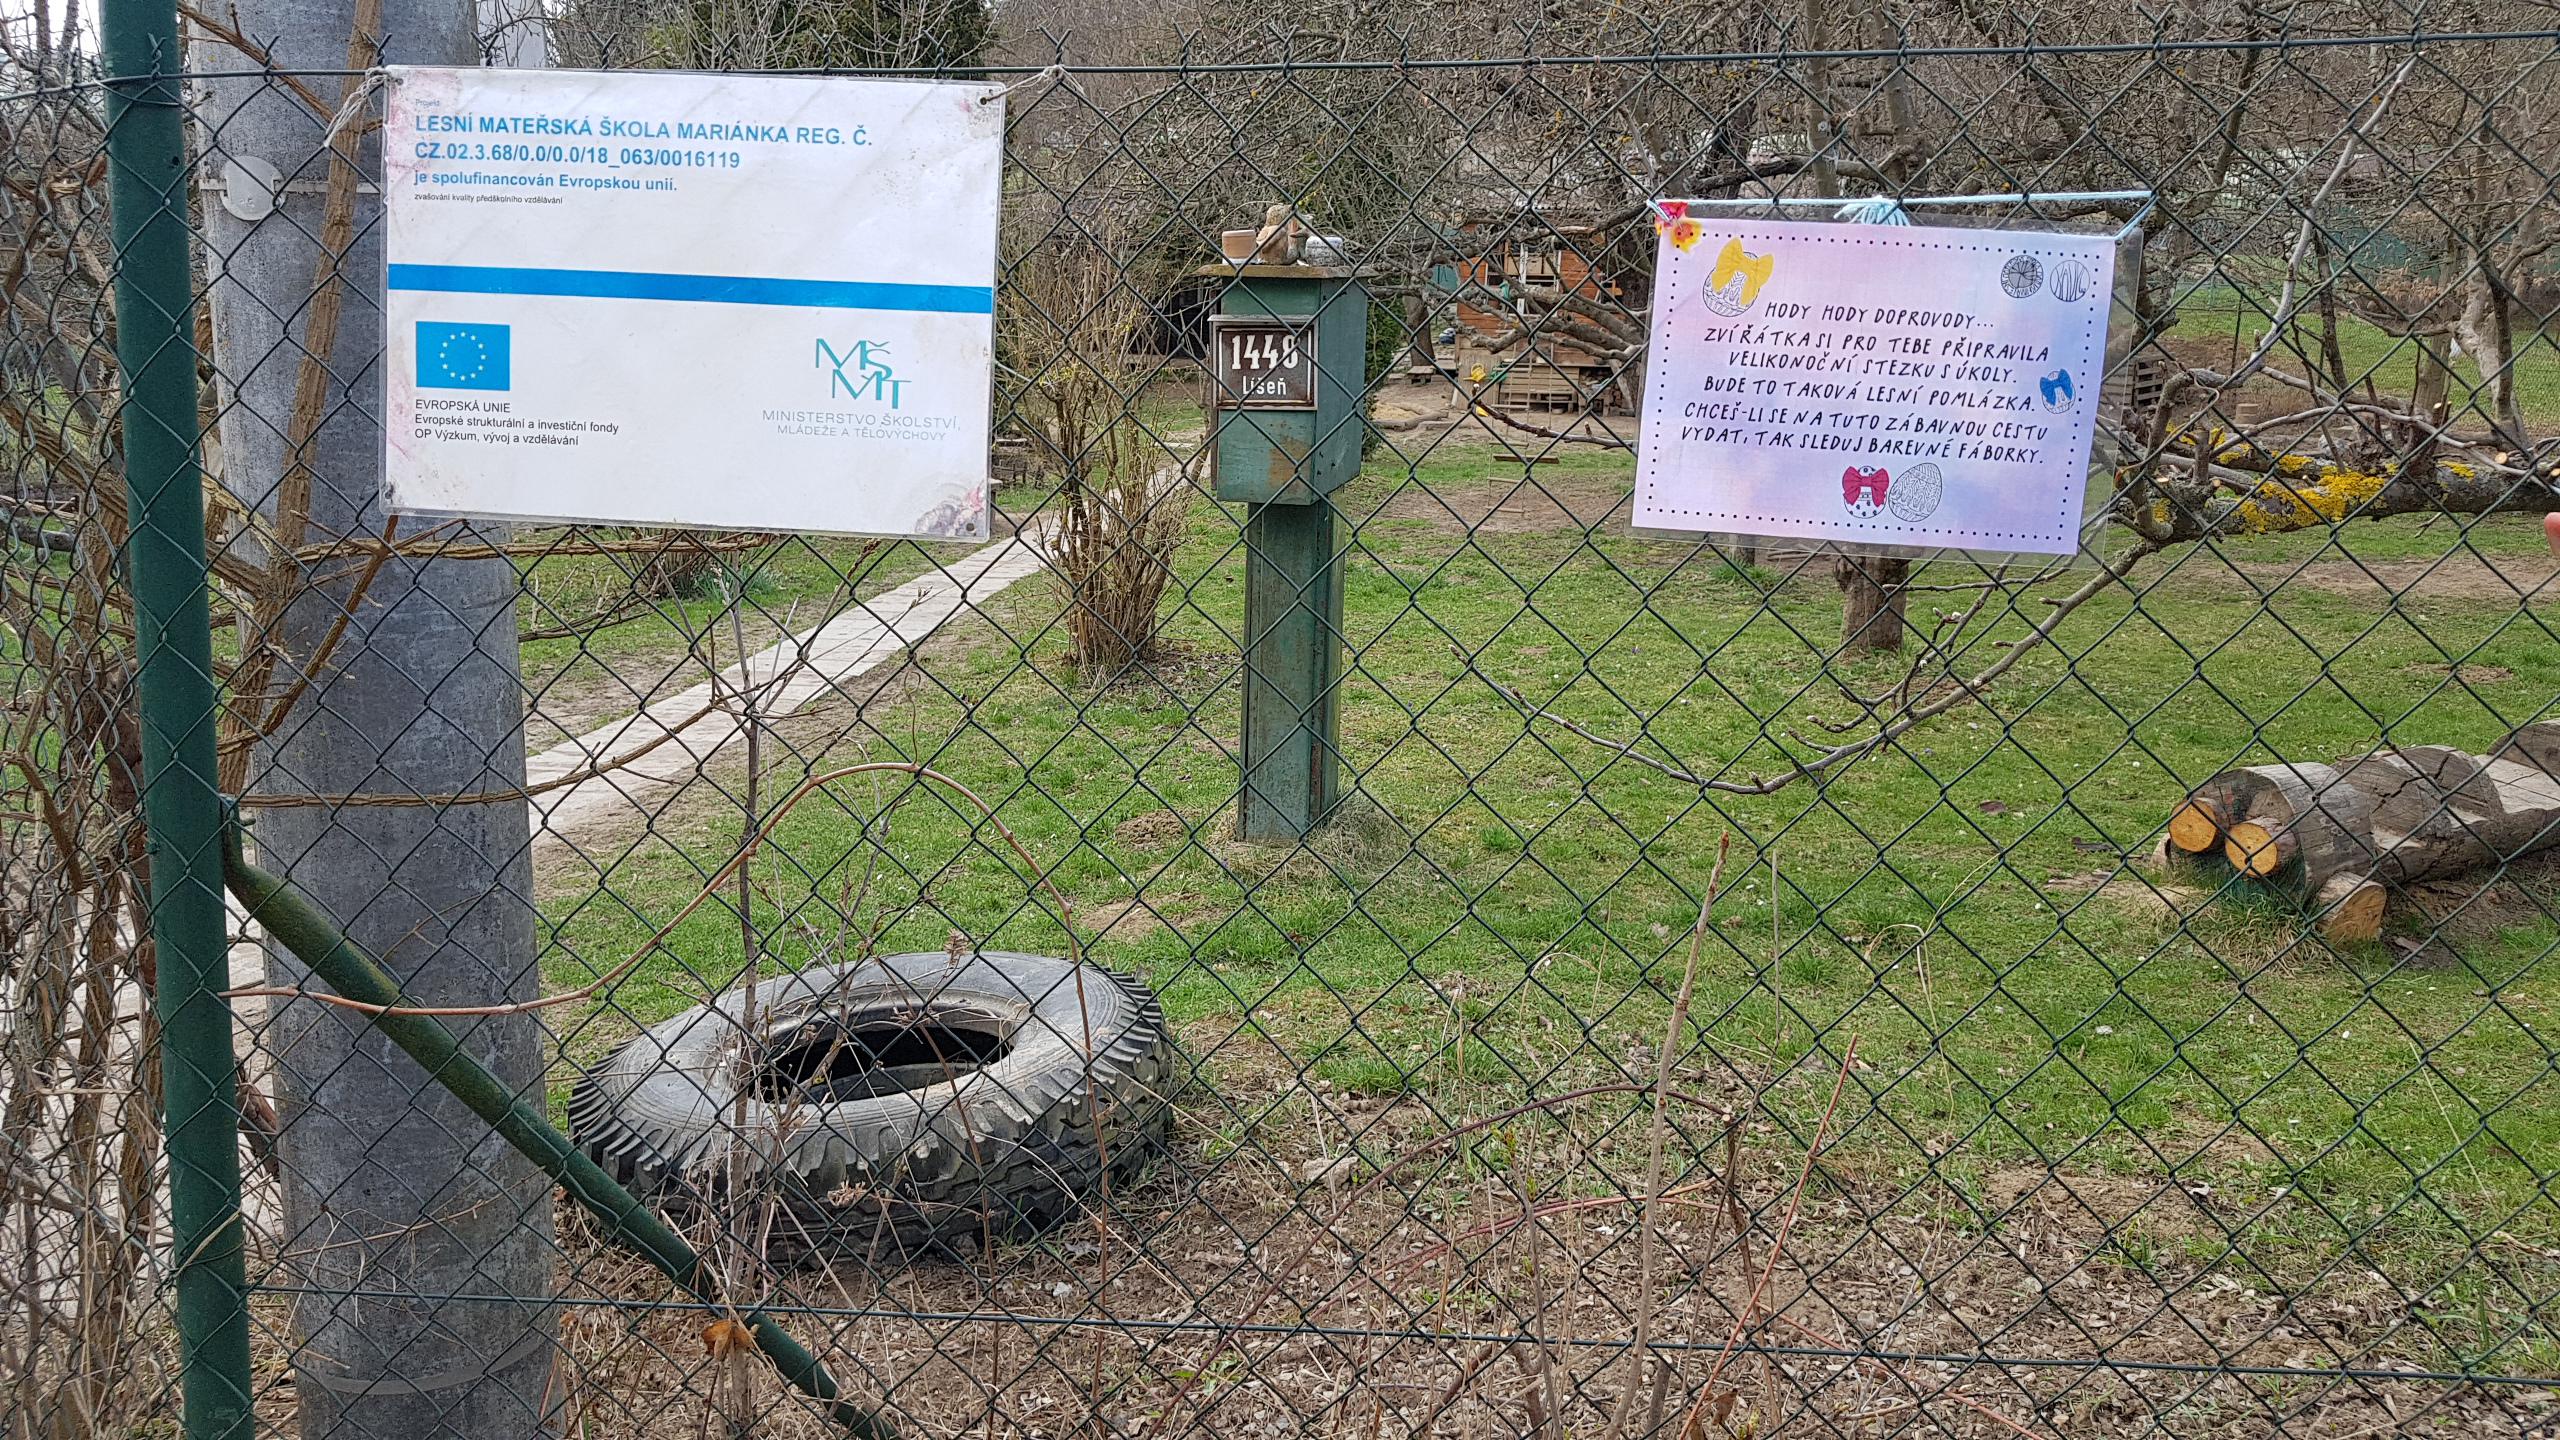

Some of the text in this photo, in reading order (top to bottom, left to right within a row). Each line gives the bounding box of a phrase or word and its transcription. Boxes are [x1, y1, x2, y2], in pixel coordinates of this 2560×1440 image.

[415, 112, 873, 147] LESNÍ MATEŘSKÁ ŠKOLA MARIÁNKA REG. Č.
[415, 142, 740, 168] CZ.02.3.68/0.0/0.0/18_063/0016119
[414, 170, 678, 191] je spolufinancován Evropskou unií.
[452, 194, 474, 202] kvality
[1765, 302, 1994, 329] HODY HODY DOPROVODY...
[1704, 323, 2049, 362] ZVÍŘÁTKA SI PRO TEBE PŘIPRAVILA
[1729, 351, 2017, 383] VELIKONOČNÍ STEZKU S ÚKOLY.
[415, 399, 511, 413] EVROPSKÁ UNIE
[1704, 375, 2035, 412] BUDE TO TAKOVÁ LESNÍ POMLÁZKA.
[415, 414, 619, 435] Evropské strukturální a investiční fondy
[763, 410, 961, 431] MINISTERSTVO ŠKOLSTVÍ,
[777, 424, 946, 441] MLÁDEŽE A TĚLOVÝCHOVY
[1684, 401, 2048, 441] CHCEŠ-LI SE NA TUTO ZÁBAVNOU CESTU
[415, 428, 579, 446] OP Výzkum, vývoj a vzdělávání
[1682, 426, 2044, 464] VYDAT, TAK SLEDUJ BAREVNÉ FÁBORKY.
